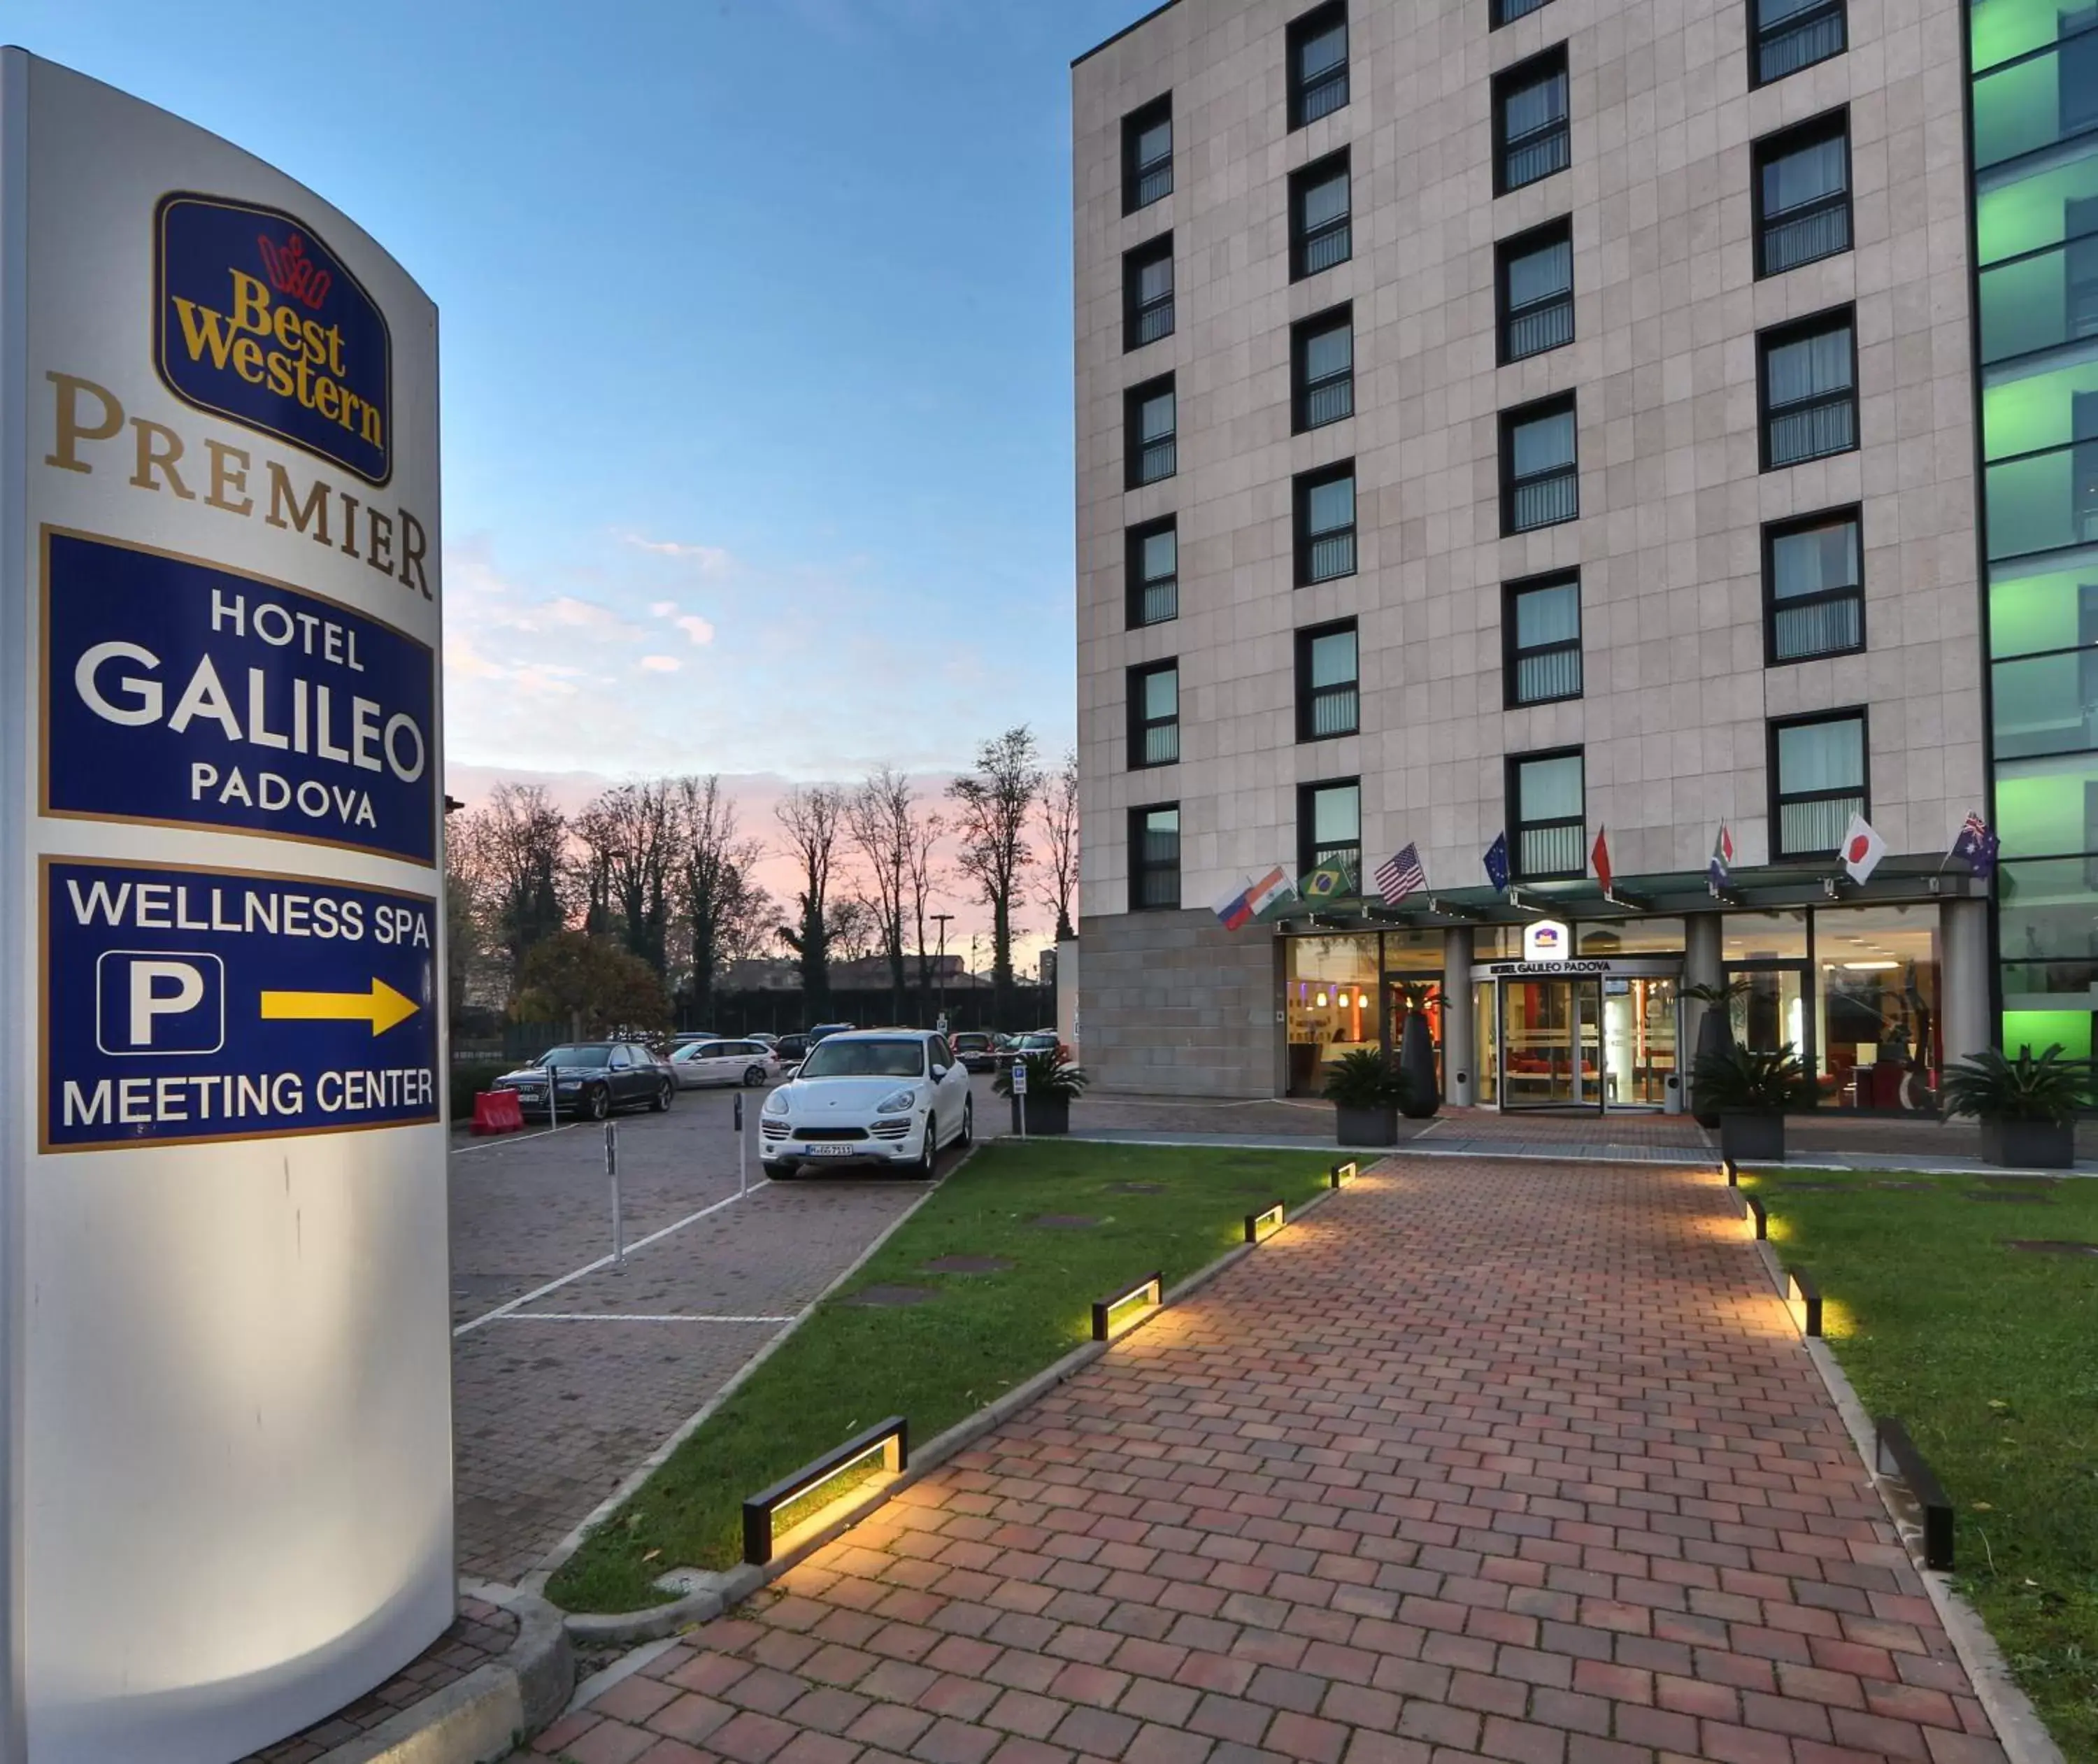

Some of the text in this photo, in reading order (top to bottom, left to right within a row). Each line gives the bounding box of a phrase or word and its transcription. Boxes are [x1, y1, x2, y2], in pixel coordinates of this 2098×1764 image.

[229, 269, 345, 377] Best
[172, 295, 385, 450] Western
[45, 370, 433, 602] PREMIER
[211, 589, 364, 672] HOTEL
[74, 641, 425, 783] GALILEO
[191, 762, 378, 829] PADOVA
[66, 879, 431, 948] WELLNESS SPA
[129, 960, 205, 1045] P
[1517, 962, 1562, 973] GALILEO
[1564, 961, 1611, 971] PADOVA
[63, 1069, 433, 1127] MEETING CENTER
